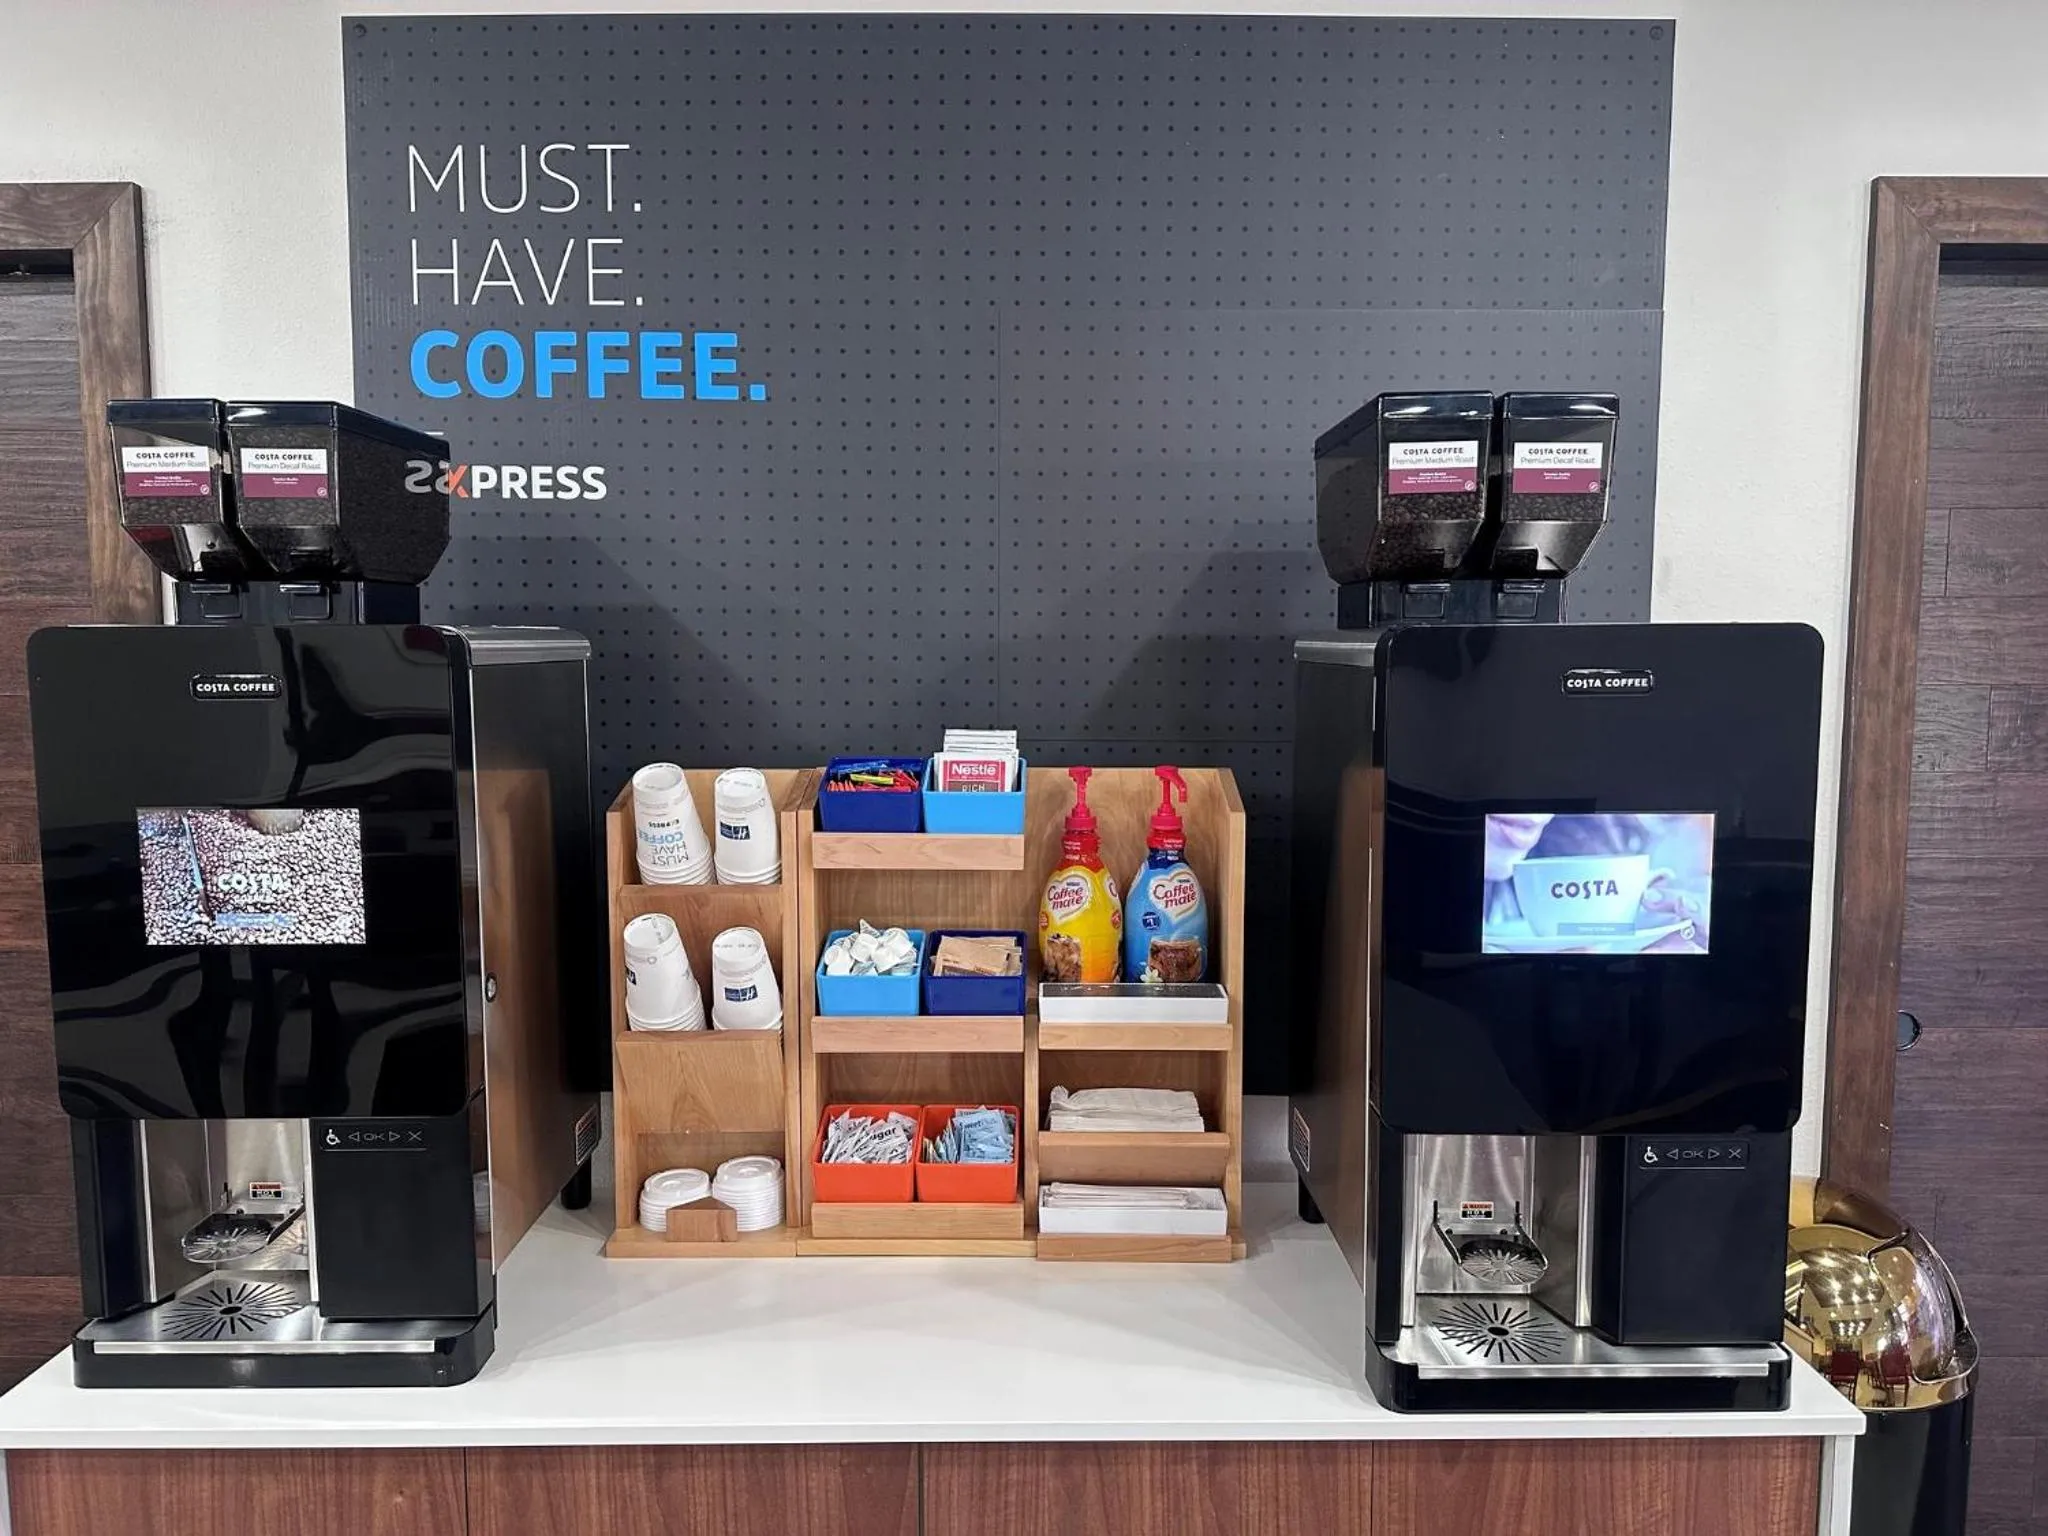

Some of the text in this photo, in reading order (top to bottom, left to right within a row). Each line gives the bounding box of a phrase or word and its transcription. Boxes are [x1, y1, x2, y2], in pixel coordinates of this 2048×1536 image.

[408, 143, 643, 213] MUST.
[411, 238, 644, 306] HAVE.
[410, 329, 767, 401] COFFEE.
[136, 451, 196, 460] COSTA COFFEE
[254, 453, 313, 461] COSTA COFFEE
[1402, 448, 1429, 456] COSTA
[1528, 448, 1554, 456] COSTA
[449, 464, 607, 500] XPRESS
[196, 683, 276, 693] COSTA COFFEE
[1566, 678, 1649, 689] COSTA COFFEE
[1047, 886, 1084, 901] Coffee
[1153, 883, 1194, 900] Coffee
[1550, 879, 1619, 900] COSTA
[1052, 896, 1083, 910] mate
[1165, 891, 1196, 908] mate
[363, 1132, 386, 1141] OK
[869, 1127, 897, 1140] ugar
[1682, 1150, 1705, 1159] OK
